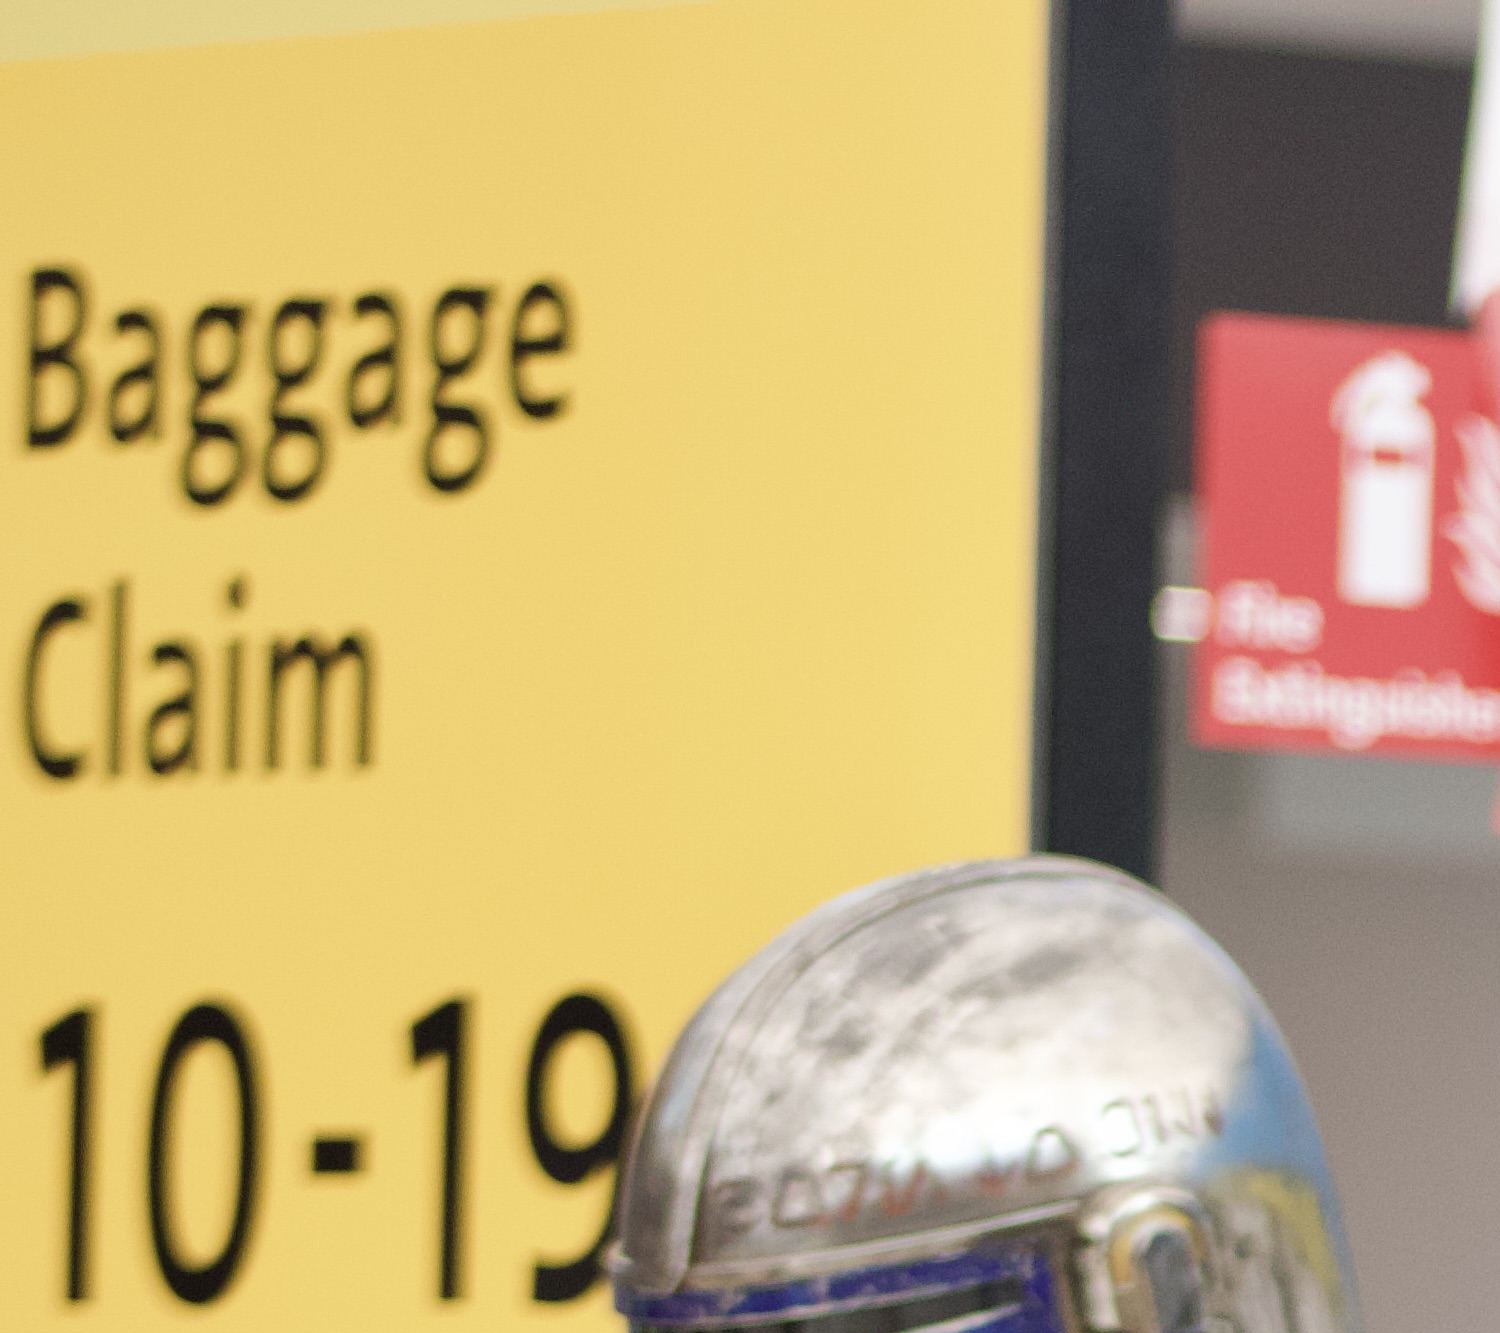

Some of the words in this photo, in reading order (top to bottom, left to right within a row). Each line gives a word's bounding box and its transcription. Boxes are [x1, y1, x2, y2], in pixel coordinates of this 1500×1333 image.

[20, 262, 576, 512] Baggage
[18, 572, 376, 786] Claim
[33, 985, 646, 1312] 10-19
